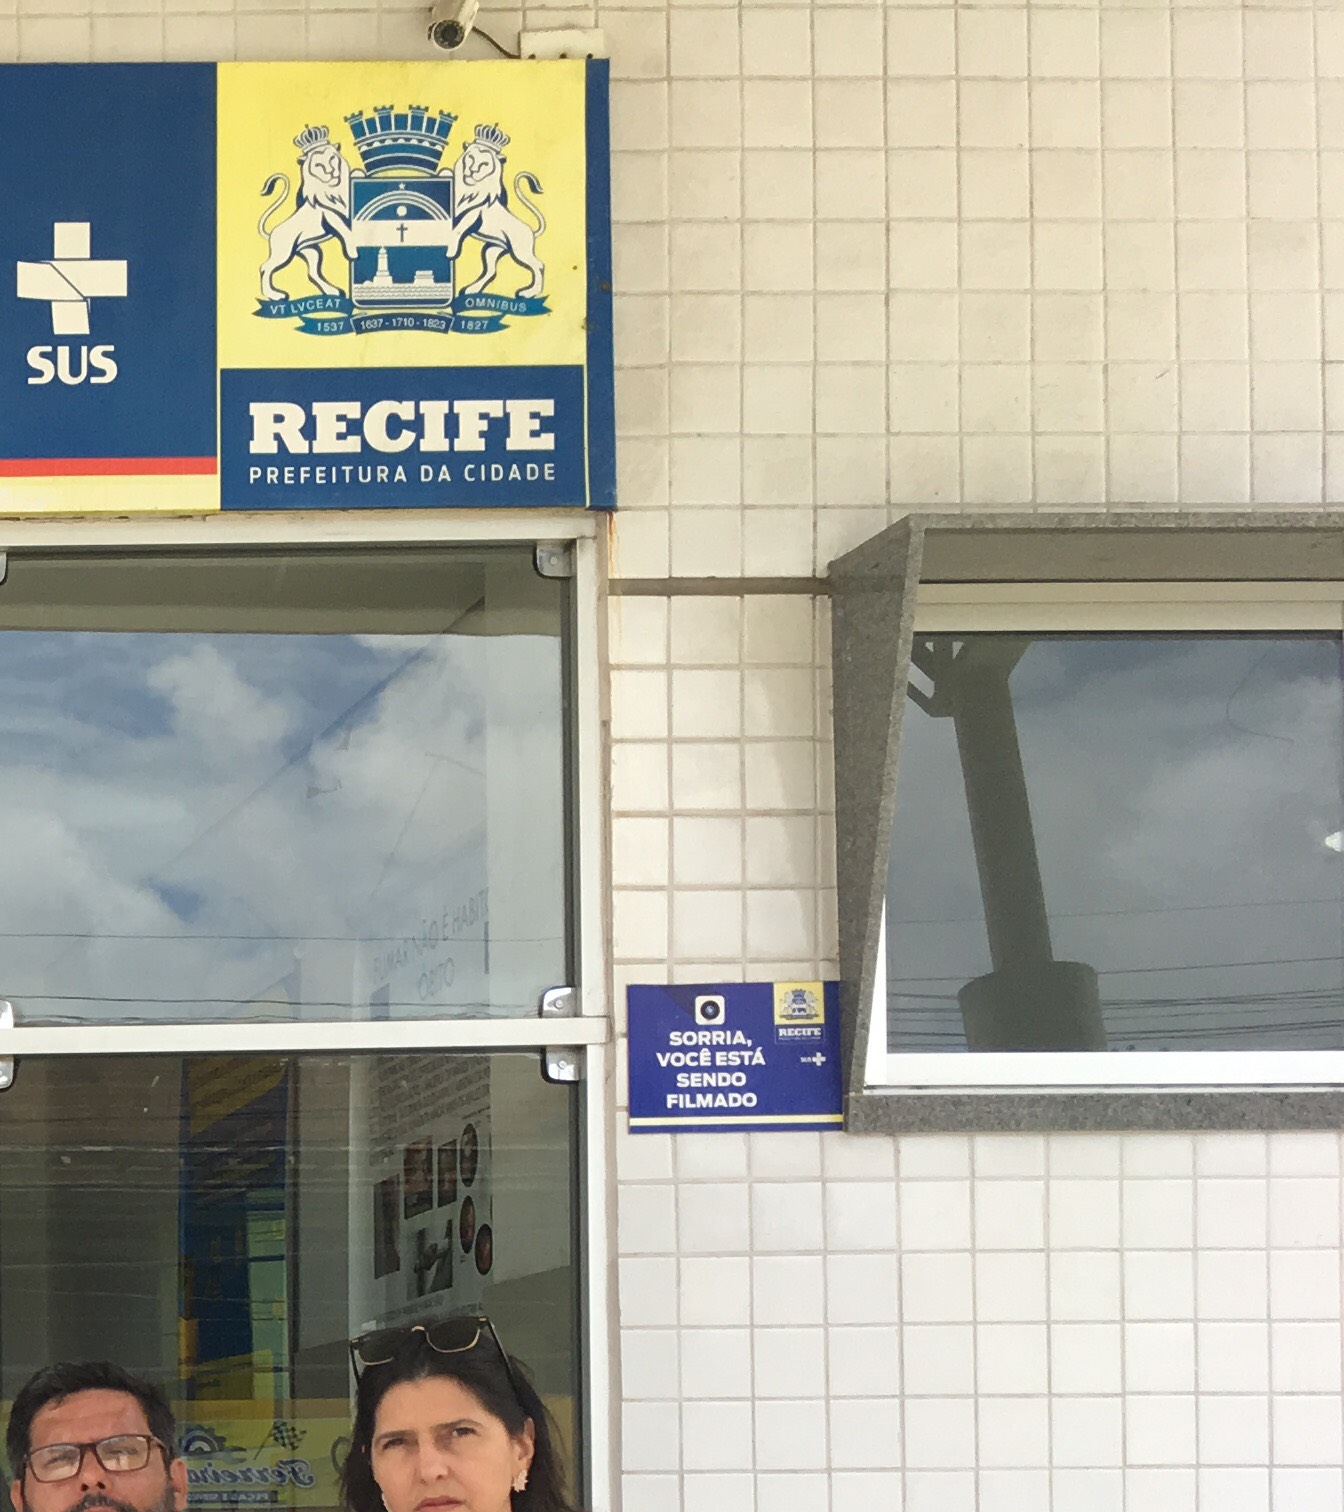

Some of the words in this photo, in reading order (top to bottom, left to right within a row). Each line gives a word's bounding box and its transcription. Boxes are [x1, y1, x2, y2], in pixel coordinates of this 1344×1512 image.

[464, 297, 528, 313] OMNIBUS
[316, 321, 345, 332] 1537
[461, 320, 490, 331] 1827
[27, 345, 118, 385] SUS
[249, 399, 555, 454] RECIFE
[250, 466, 407, 484] PREFEITURA
[420, 465, 452, 482] DA
[464, 464, 556, 482] CIDADE
[669, 1031, 753, 1048] SORRIA,
[656, 1048, 711, 1067] VOCÊ
[715, 1047, 766, 1066] ESTÁ
[676, 1072, 747, 1088] SENDO
[666, 1092, 758, 1109] FILMADO
